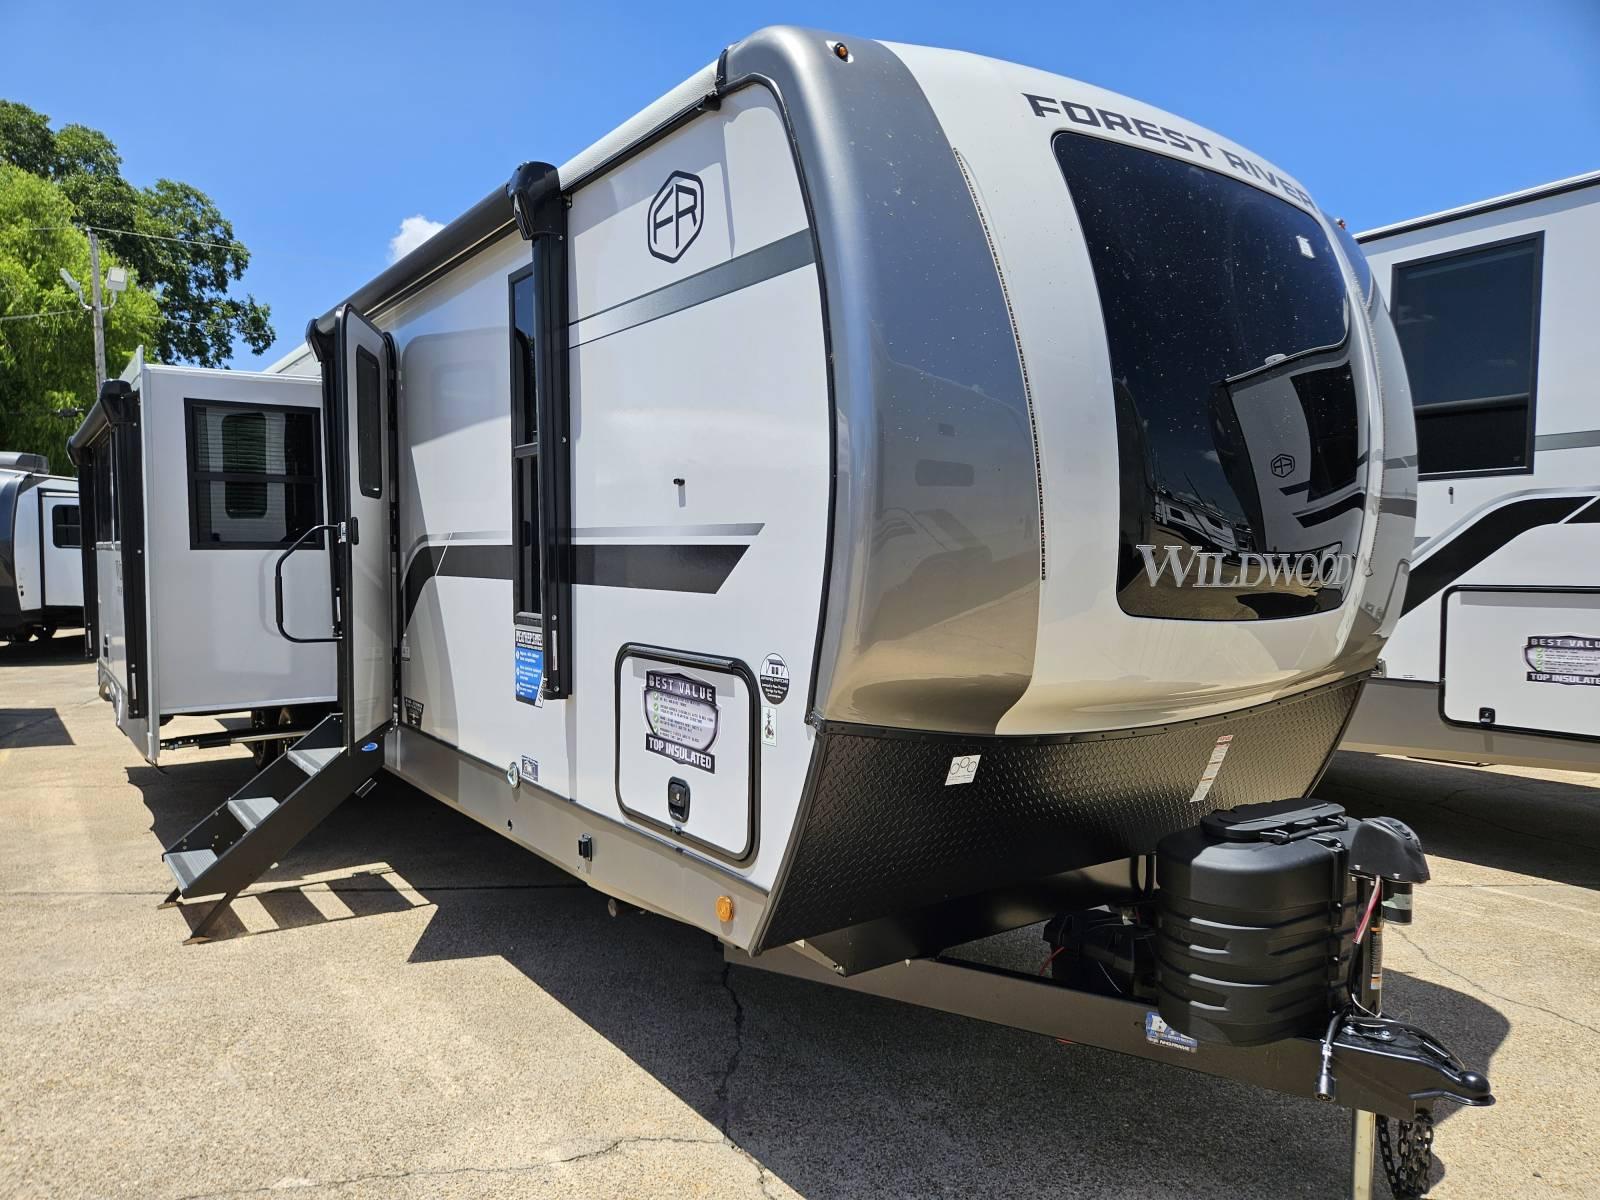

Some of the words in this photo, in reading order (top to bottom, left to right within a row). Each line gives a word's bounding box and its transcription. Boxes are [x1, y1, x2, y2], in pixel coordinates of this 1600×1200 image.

[1021, 92, 1211, 158] FOREST
[1218, 147, 1315, 209] RIVER
[1530, 638, 1562, 647] BEST
[1568, 639, 1600, 648] VALU
[649, 675, 674, 690] BEST
[678, 681, 713, 702] VALUE
[1530, 673, 1551, 681] TOP
[1552, 674, 1600, 685] INSULATE
[648, 736, 664, 752] TOP
[666, 742, 712, 769] INSULATED
